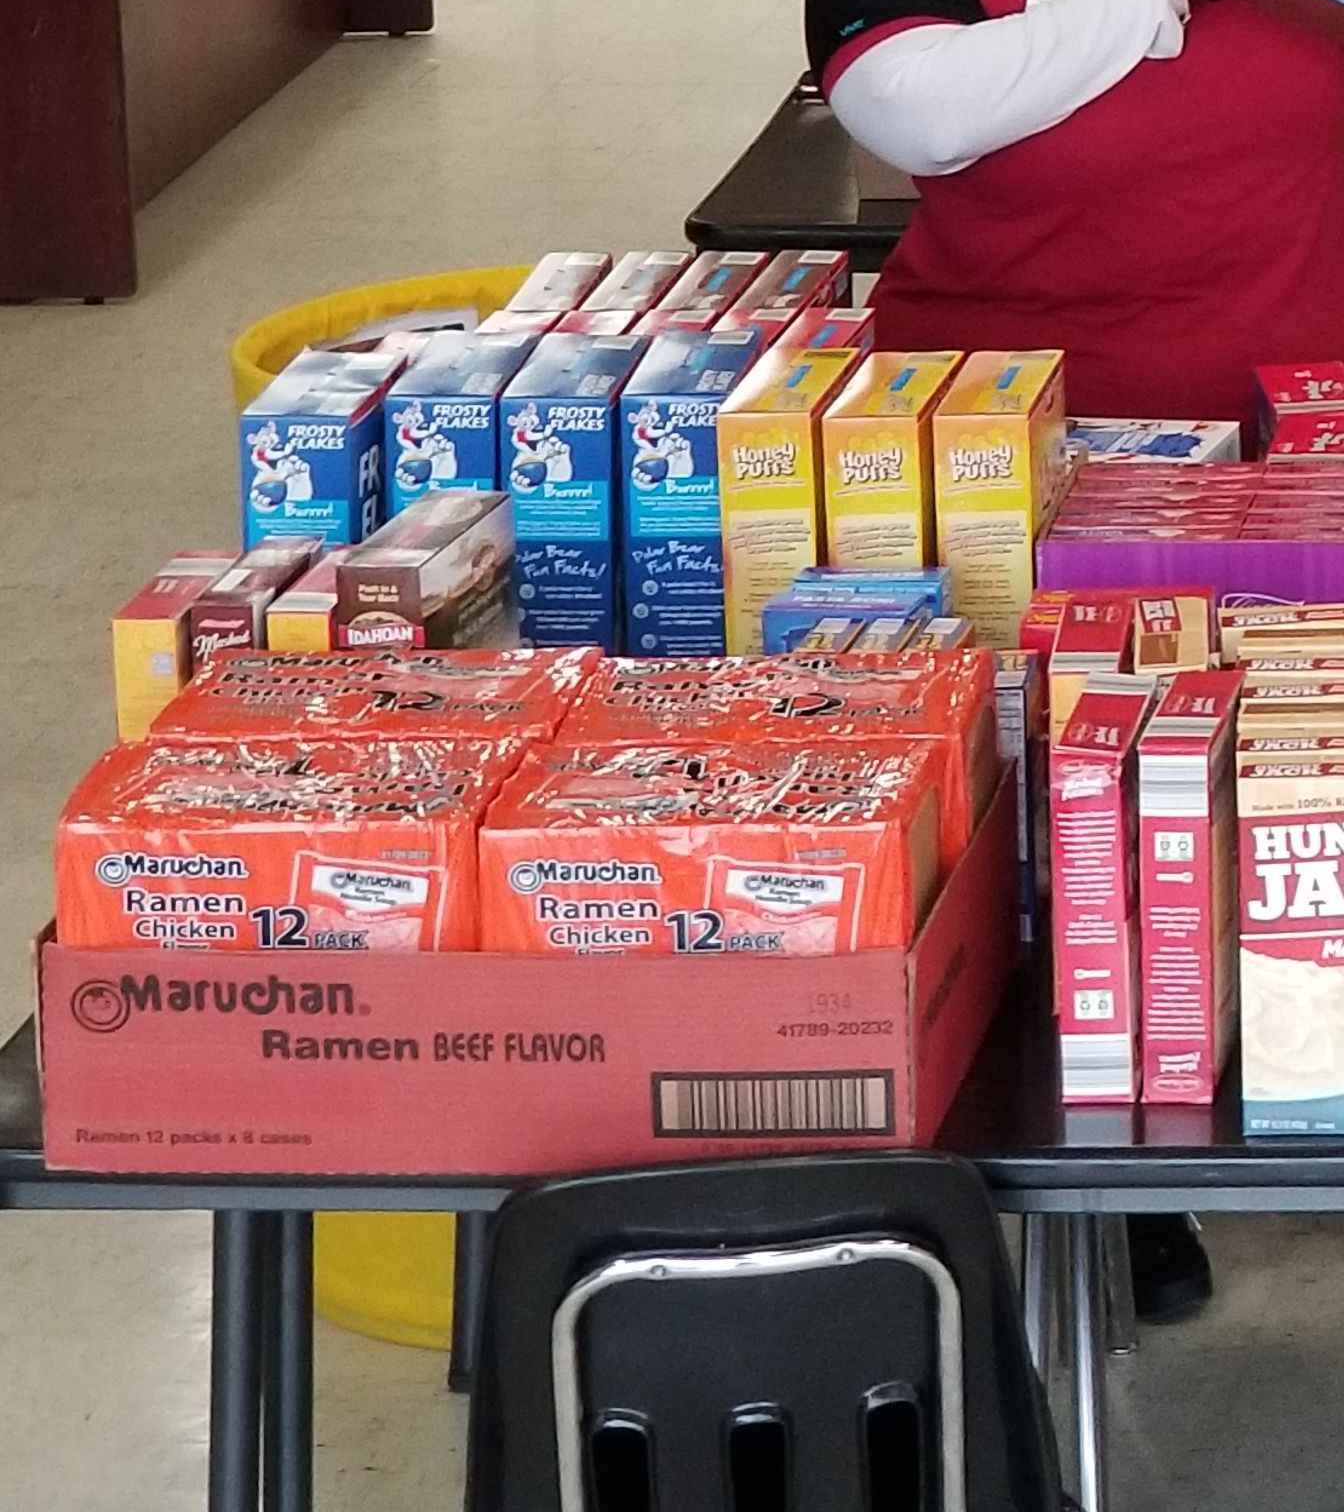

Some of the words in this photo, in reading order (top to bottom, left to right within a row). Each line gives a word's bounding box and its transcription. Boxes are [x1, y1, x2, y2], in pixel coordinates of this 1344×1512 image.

[433, 402, 490, 418] FROSTY
[548, 406, 606, 420] FROSTY
[286, 424, 347, 438] FROSTY
[435, 415, 490, 430] FLAKES
[552, 418, 605, 432] FLAKES
[290, 436, 344, 450] FLAKES
[732, 442, 796, 465] Honey
[949, 442, 1014, 465] Honey
[839, 445, 904, 468] Honey
[347, 624, 415, 647] IDAHOAN
[1298, 797, 1332, 809] 100%
[125, 854, 244, 878] Maruchan
[538, 861, 658, 883] Maruchan
[125, 890, 244, 915] Ramen
[539, 896, 659, 920] Ramen
[134, 919, 236, 941] Chicken
[251, 907, 310, 949] 12
[312, 930, 368, 950] PACK
[548, 927, 651, 946] Chicken
[665, 912, 725, 952] 12
[728, 934, 783, 951] PACK
[120, 973, 356, 1015] Maruchan
[261, 1029, 421, 1061] Ramen
[432, 1032, 495, 1062] BEEF
[504, 1033, 606, 1063] FLAVOR
[75, 1127, 141, 1145] Ramen
[145, 1129, 165, 1145] 12
[169, 1130, 223, 1147] packs
[259, 1132, 313, 1147] cases
